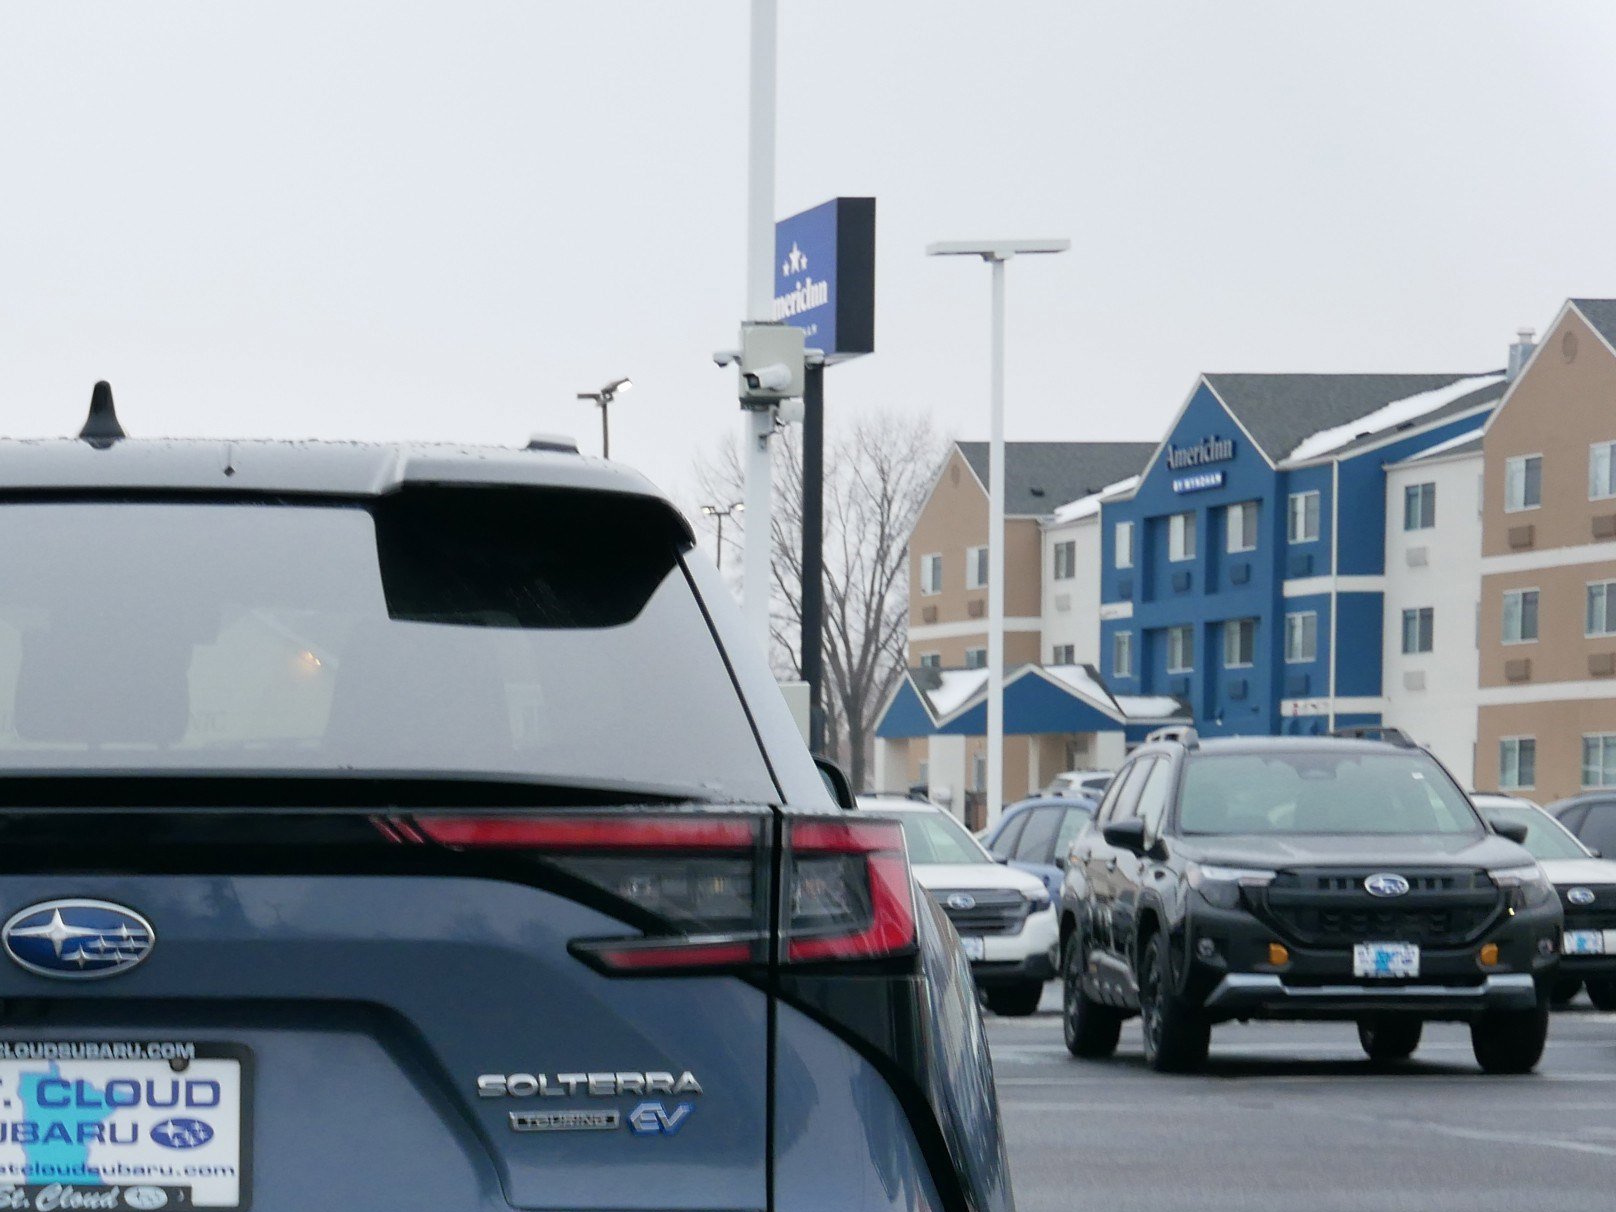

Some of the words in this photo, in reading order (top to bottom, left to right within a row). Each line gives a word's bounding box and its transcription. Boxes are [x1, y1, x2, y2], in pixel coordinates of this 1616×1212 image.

[772, 277, 828, 321] mericInn
[1167, 434, 1233, 470] AmericInn
[36, 1079, 221, 1109] CLOUD
[477, 1070, 703, 1097] SOLTERRA
[629, 1102, 696, 1136] EV
[35, 1182, 120, 1212] Cloud
